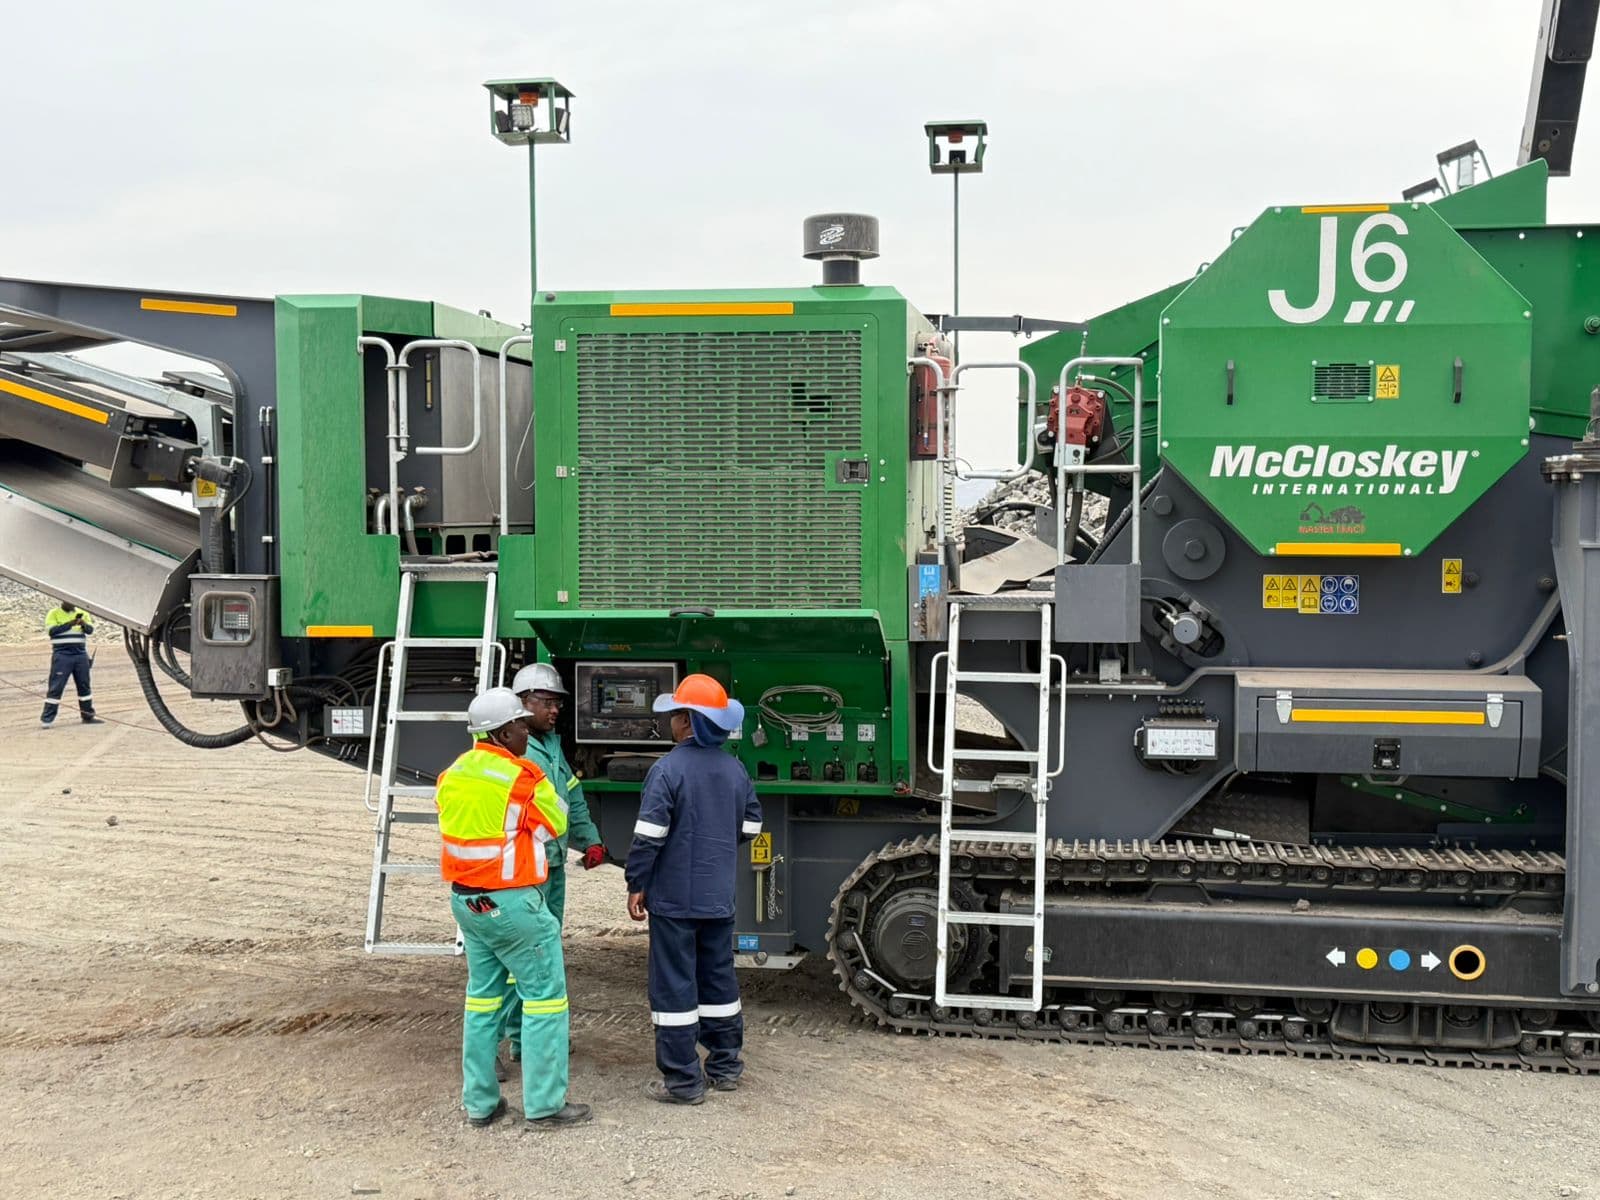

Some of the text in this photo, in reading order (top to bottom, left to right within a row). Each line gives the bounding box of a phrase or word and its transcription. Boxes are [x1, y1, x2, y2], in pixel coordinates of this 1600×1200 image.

[1268, 213, 1409, 324] J6
[1209, 445, 1468, 494] McCloskey
[1252, 483, 1435, 495] INTERNATIONAL
